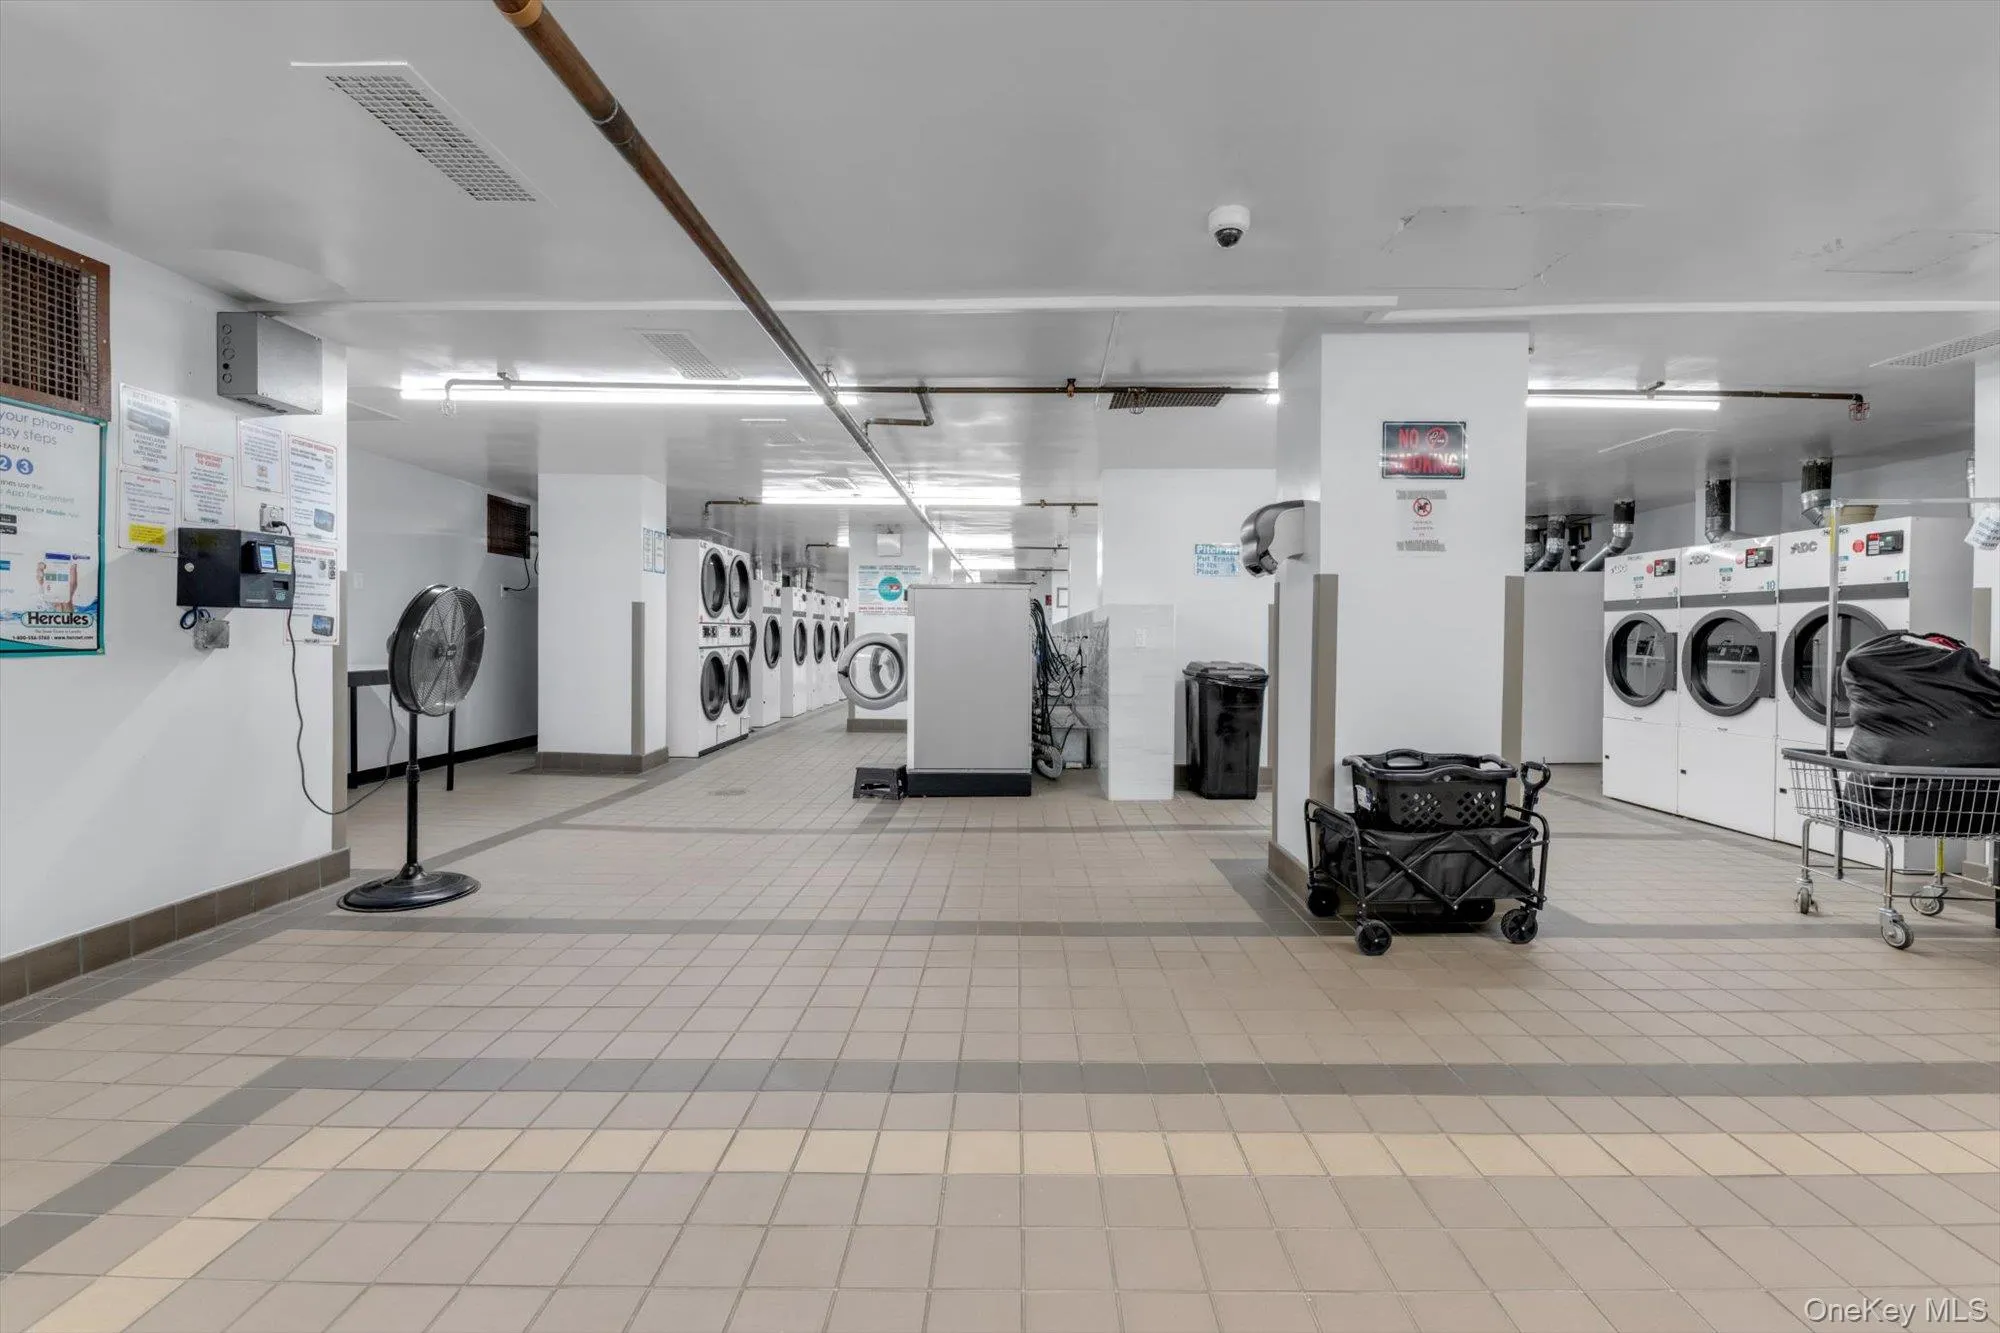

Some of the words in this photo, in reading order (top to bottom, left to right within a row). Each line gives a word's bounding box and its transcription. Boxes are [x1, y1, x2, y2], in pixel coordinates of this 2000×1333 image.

[0, 411, 29, 423] your
[32, 417, 74, 434] phone
[23, 430, 57, 446] steps
[1399, 428, 1419, 449] NO
[1790, 541, 1818, 555] ADC
[1895, 569, 1907, 582] 11
[1766, 580, 1776, 591] 10
[27, 611, 89, 626] Hercules
